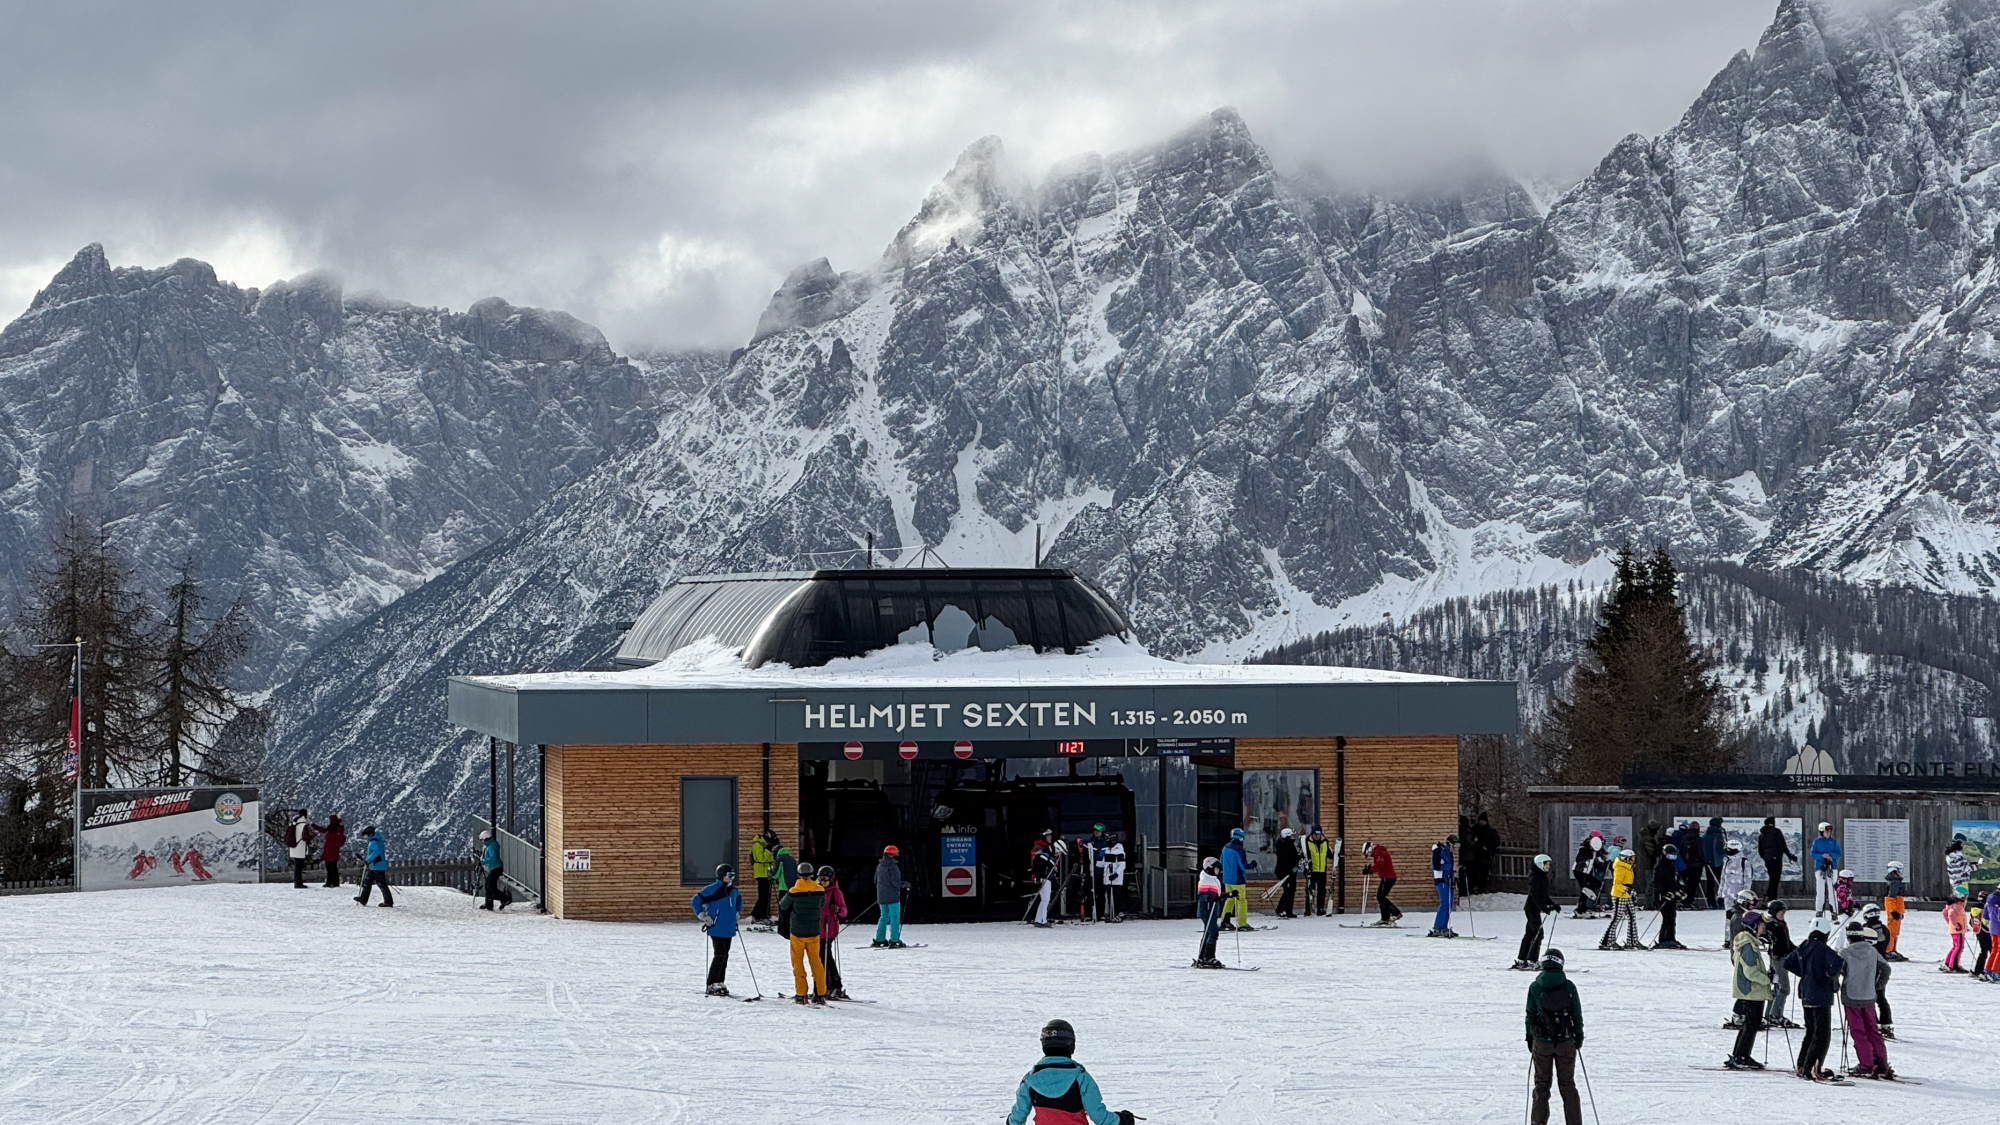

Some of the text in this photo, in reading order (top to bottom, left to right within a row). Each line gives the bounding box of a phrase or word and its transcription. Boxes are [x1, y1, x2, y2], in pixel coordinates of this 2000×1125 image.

[805, 703, 951, 733] HELMJET
[963, 702, 1096, 728] SEXTEN
[1110, 710, 1156, 725] 1.315
[1173, 709, 1226, 725] 2.050
[1231, 712, 1248, 724] m
[1877, 761, 1955, 776] MONTE
[957, 824, 978, 833] info
